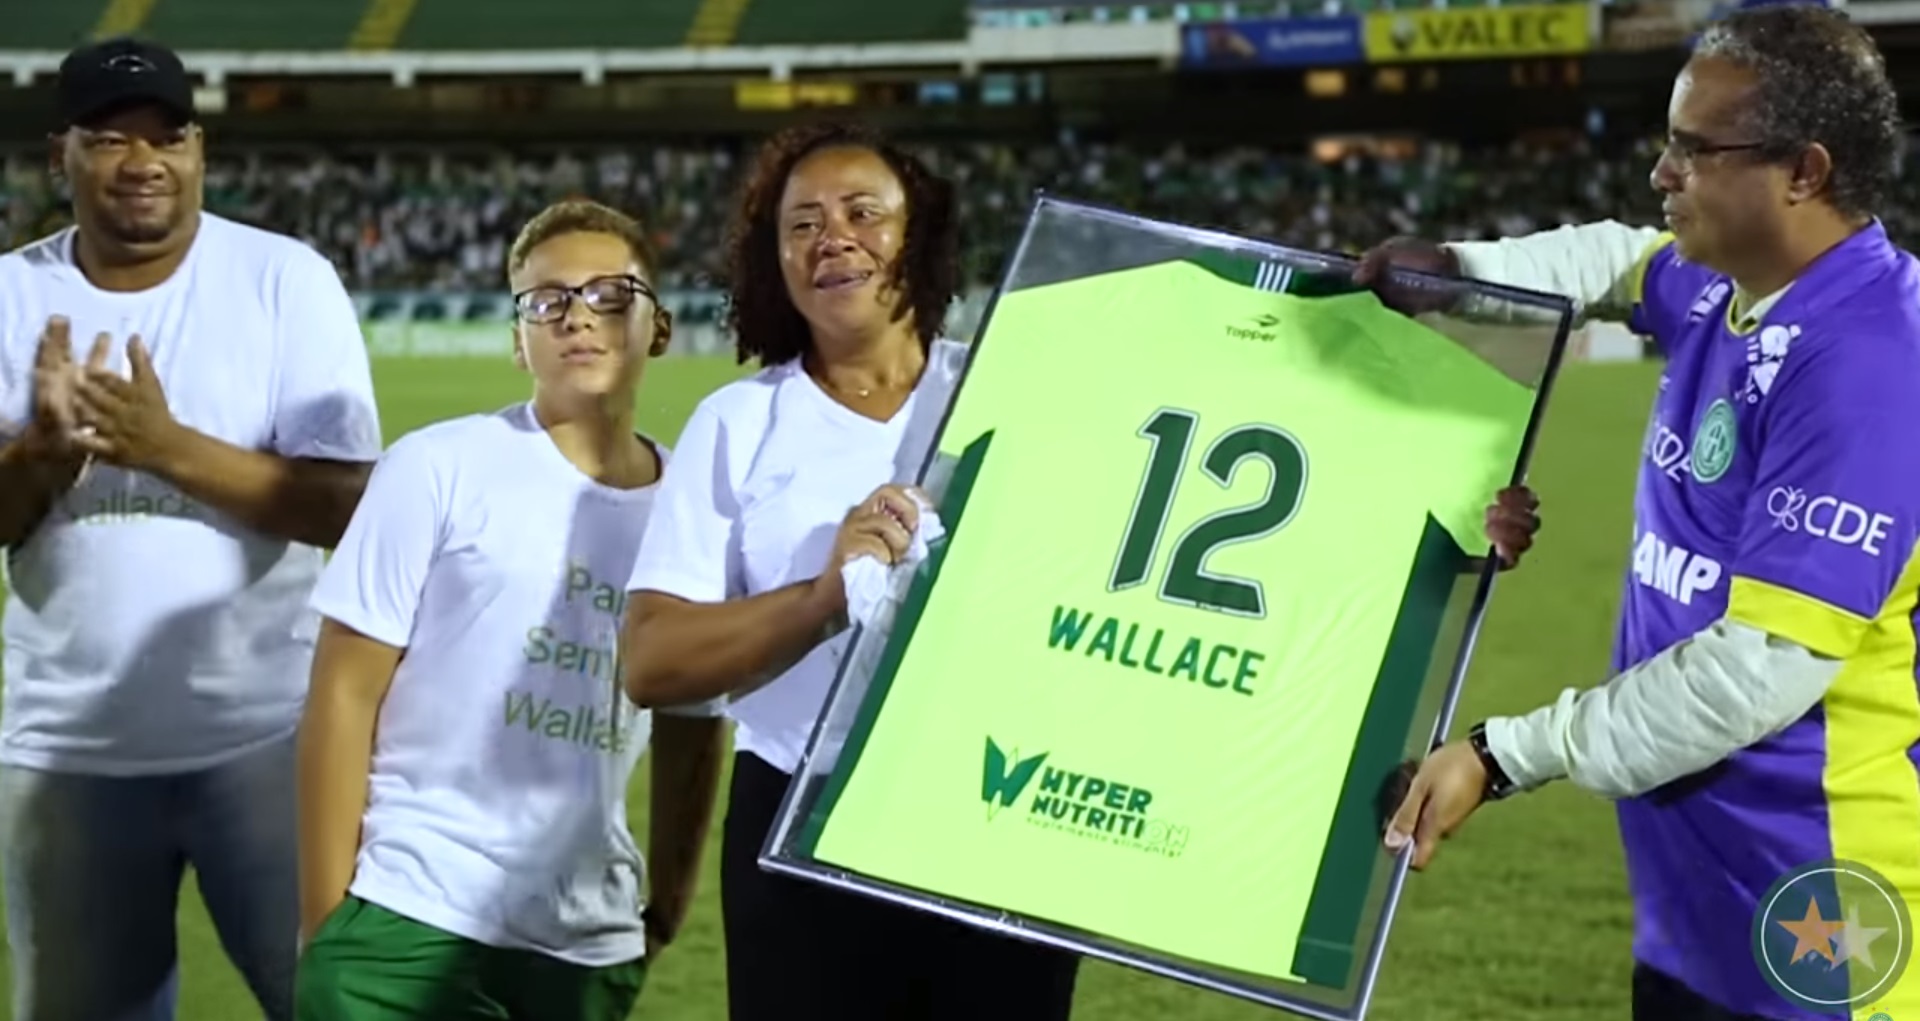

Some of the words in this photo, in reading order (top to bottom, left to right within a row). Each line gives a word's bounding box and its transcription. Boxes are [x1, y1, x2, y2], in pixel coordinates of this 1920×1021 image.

[1420, 12, 1571, 50] VALEC
[1106, 405, 1310, 620] 12
[1803, 495, 1895, 556] CDE
[1633, 530, 1722, 606] AMP
[1048, 604, 1266, 697] WALLACE
[1039, 765, 1153, 815] HYPER
[1029, 793, 1190, 849] NUTRITION
